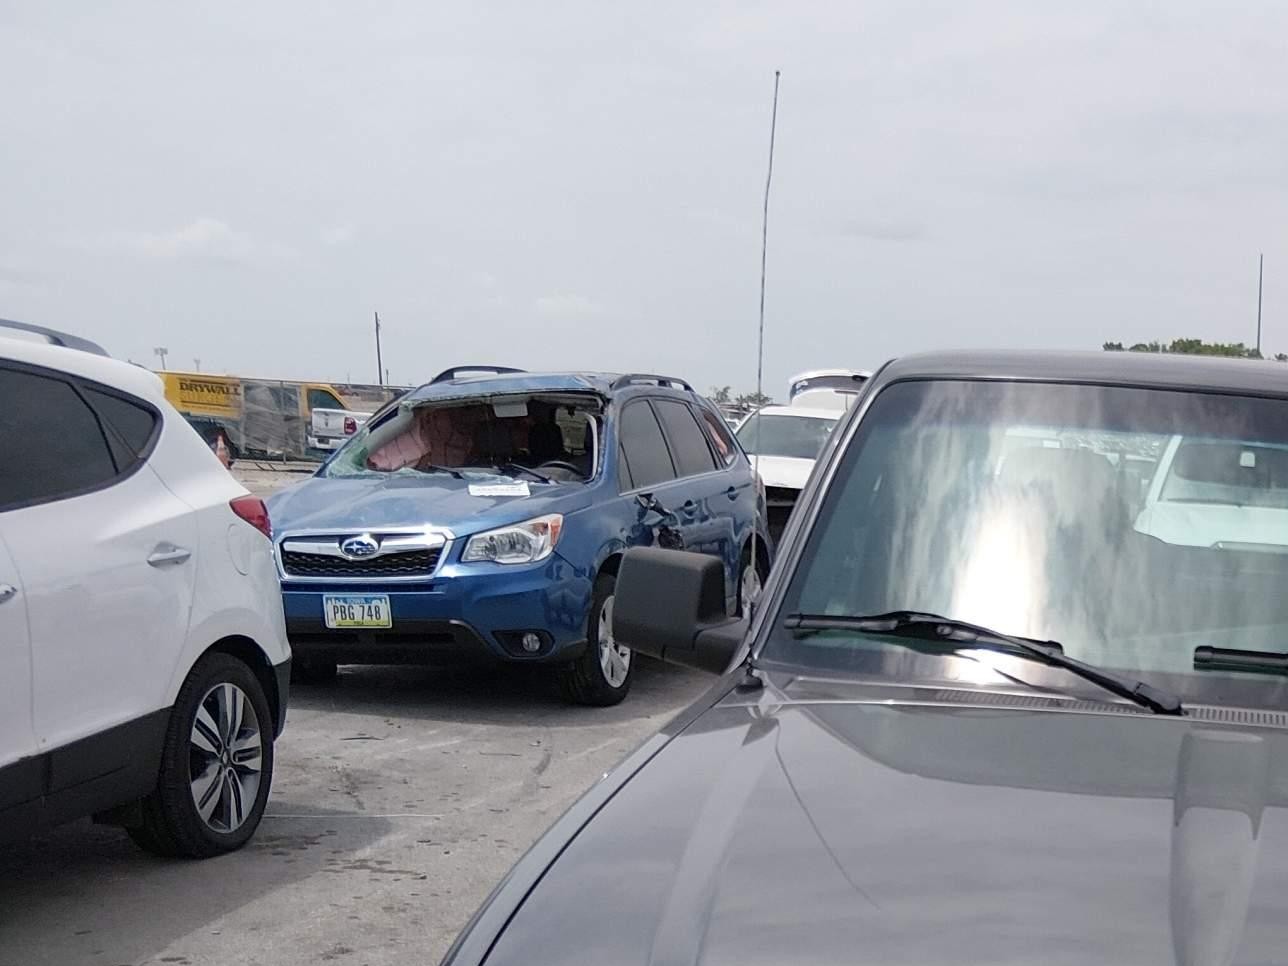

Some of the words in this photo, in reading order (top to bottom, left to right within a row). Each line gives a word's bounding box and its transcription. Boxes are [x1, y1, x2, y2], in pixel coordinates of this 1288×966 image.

[179, 382, 241, 395] DRYWALL
[333, 605, 354, 620] PBG
[360, 605, 381, 620] 748
